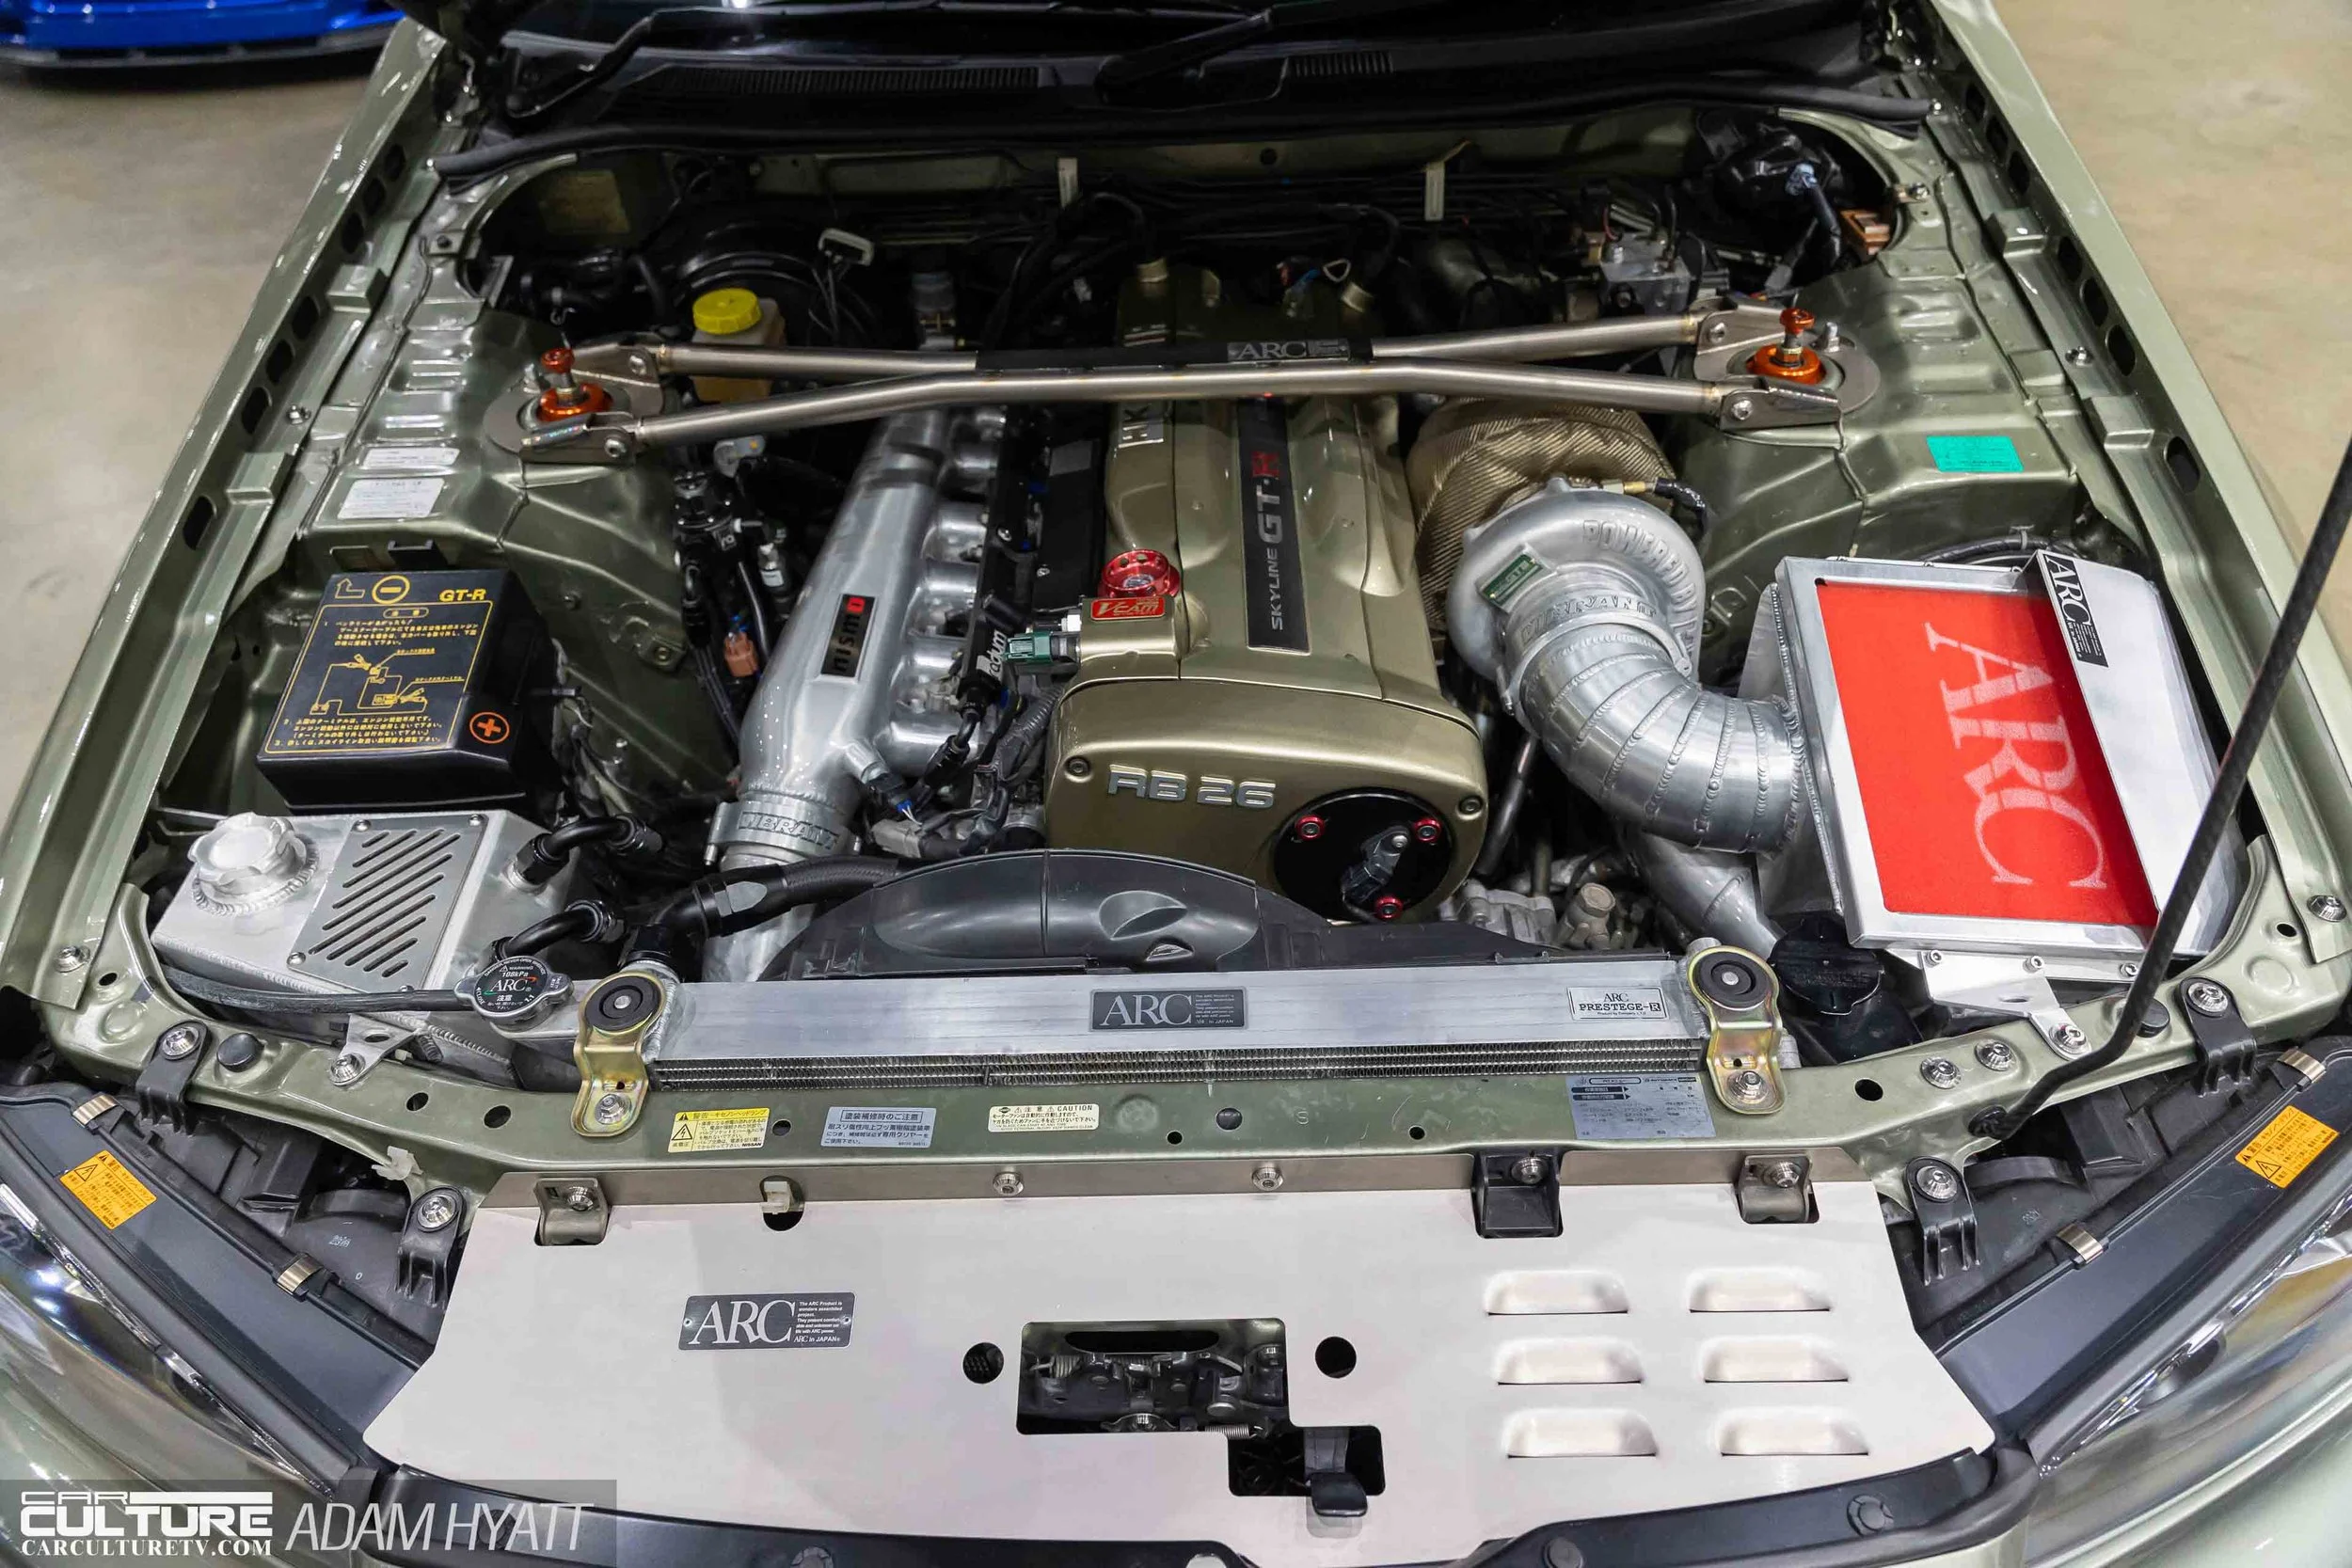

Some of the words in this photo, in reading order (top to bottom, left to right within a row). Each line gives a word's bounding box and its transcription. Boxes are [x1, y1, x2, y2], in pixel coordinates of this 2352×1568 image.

[1237, 341, 1307, 359] ARC
[438, 588, 487, 603] GT-R
[1266, 546, 1284, 631] SKYLINE
[2043, 554, 2092, 626] ARC
[1921, 621, 2108, 890] ARC
[1107, 764, 1188, 801] RB
[1196, 776, 1277, 810] 26
[490, 978, 528, 992] ARC
[1603, 992, 1629, 1003] ARC
[1099, 993, 1193, 1026] ARC
[1579, 1002, 1661, 1012] PRESTEGE-R
[688, 1299, 796, 1345] ARC
[794, 1335, 808, 1343] ARC
